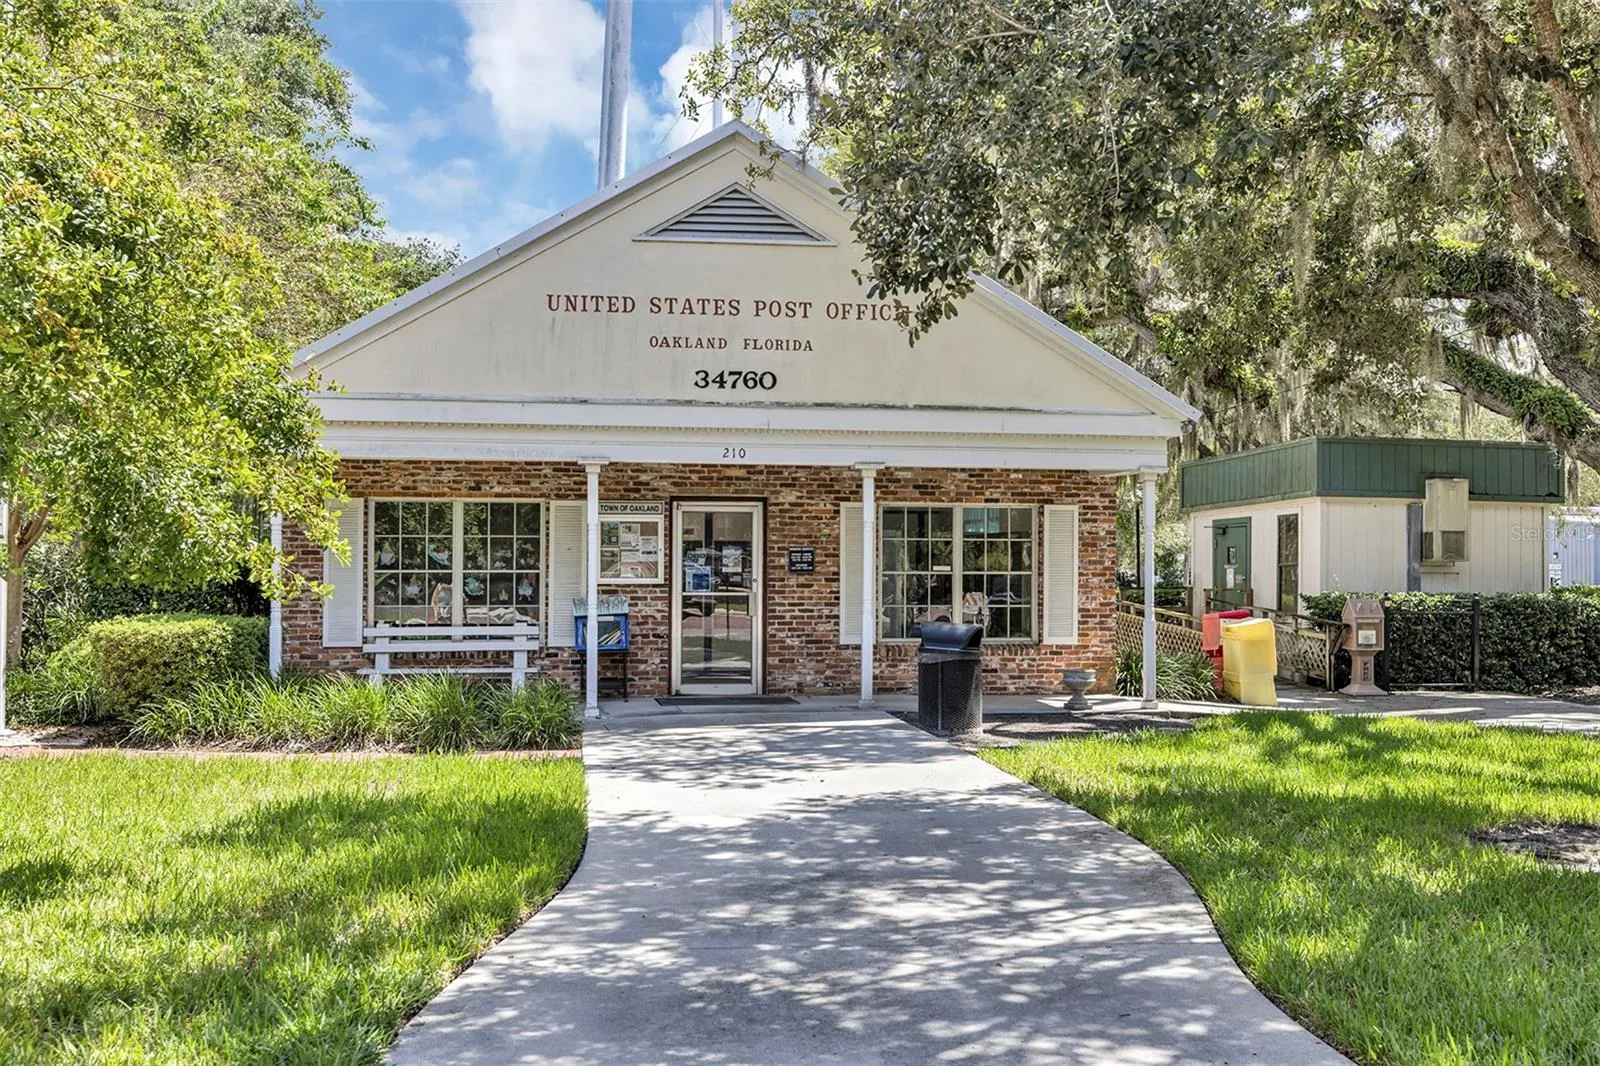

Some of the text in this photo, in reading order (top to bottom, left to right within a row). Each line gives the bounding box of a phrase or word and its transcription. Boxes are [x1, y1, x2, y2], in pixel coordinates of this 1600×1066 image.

[546, 294, 636, 314] UNITED
[649, 296, 741, 317] STATES
[753, 299, 813, 319] POST
[649, 335, 814, 352] OAKLAND FLORIDA
[693, 369, 777, 390] 34760
[722, 447, 746, 459] 210
[600, 504, 660, 512] TOWN OF OAKLAND
